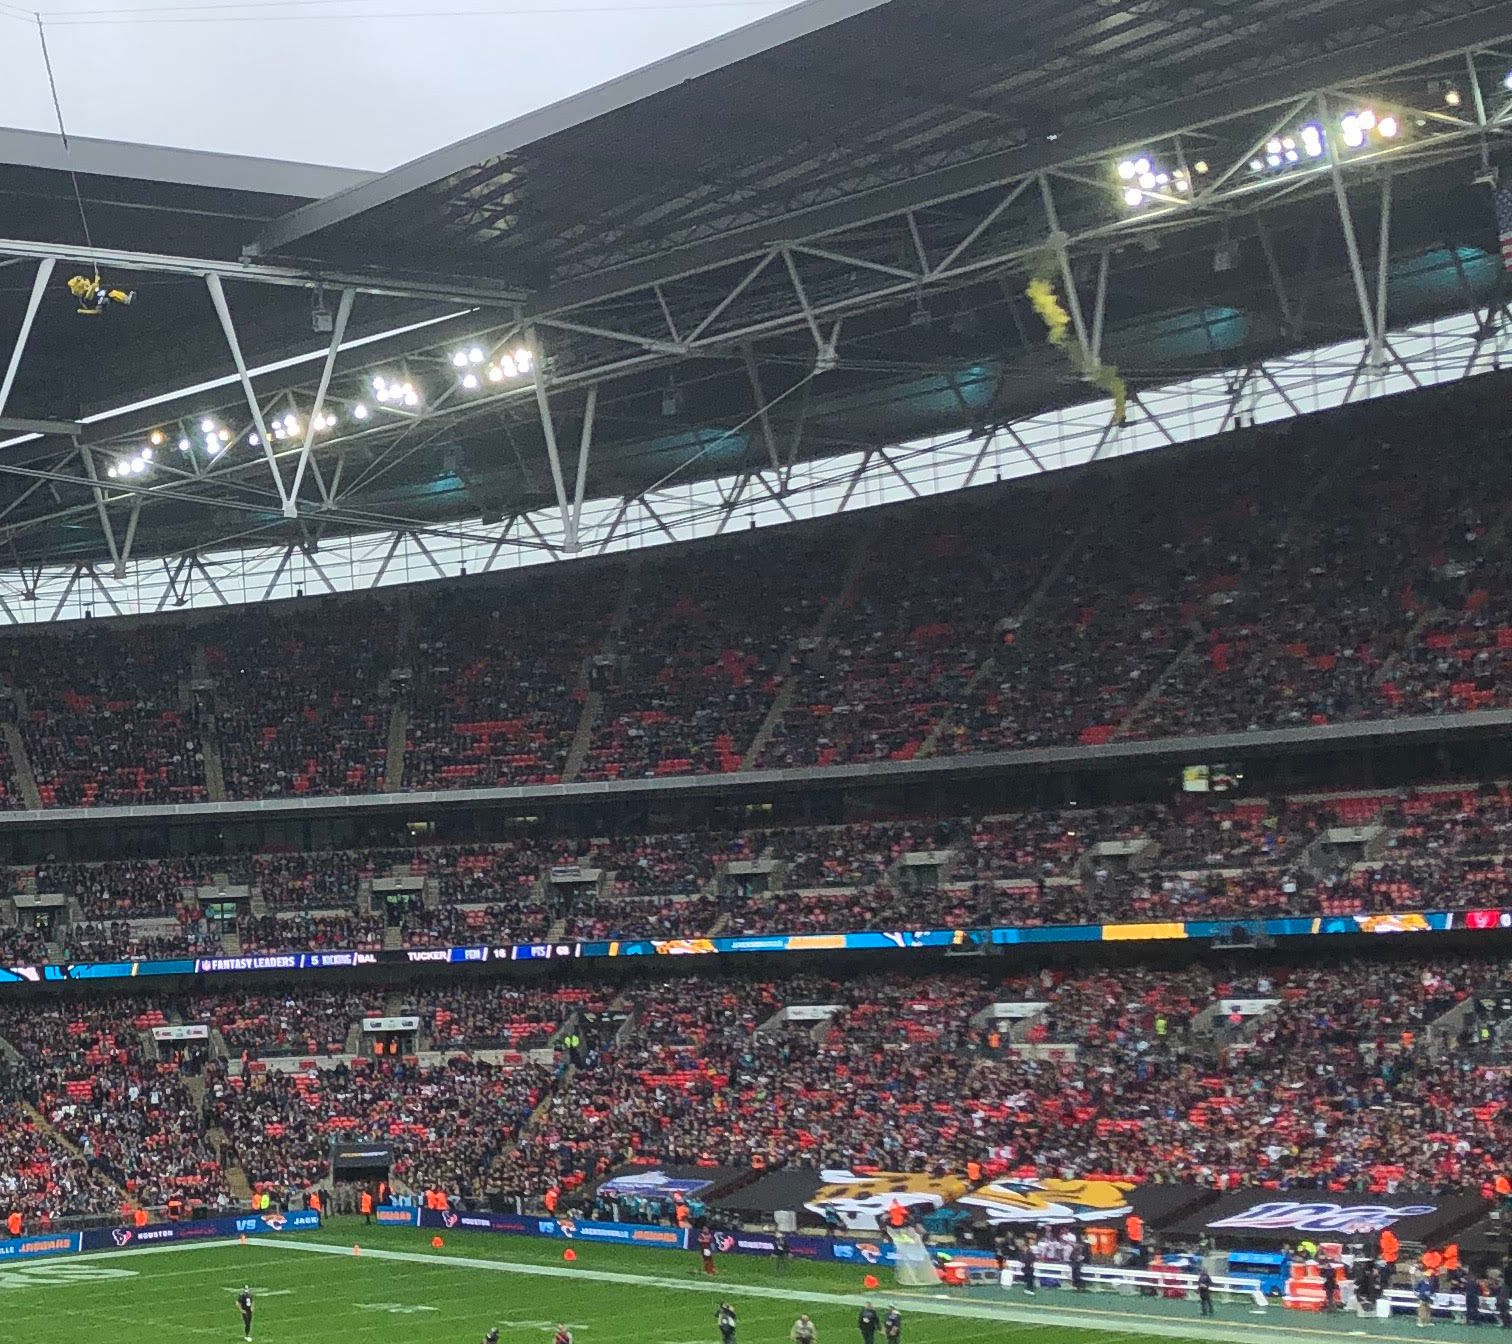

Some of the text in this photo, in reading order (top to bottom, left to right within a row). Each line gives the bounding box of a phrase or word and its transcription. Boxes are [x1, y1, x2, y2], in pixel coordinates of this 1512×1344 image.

[212, 958, 251, 970] FANTASY
[254, 956, 295, 968] LEADERS
[407, 950, 447, 962] TUCKER
[138, 1229, 173, 1240] HOUSTON
[236, 1219, 256, 1231] VS
[19, 1238, 71, 1254] JAGUARS
